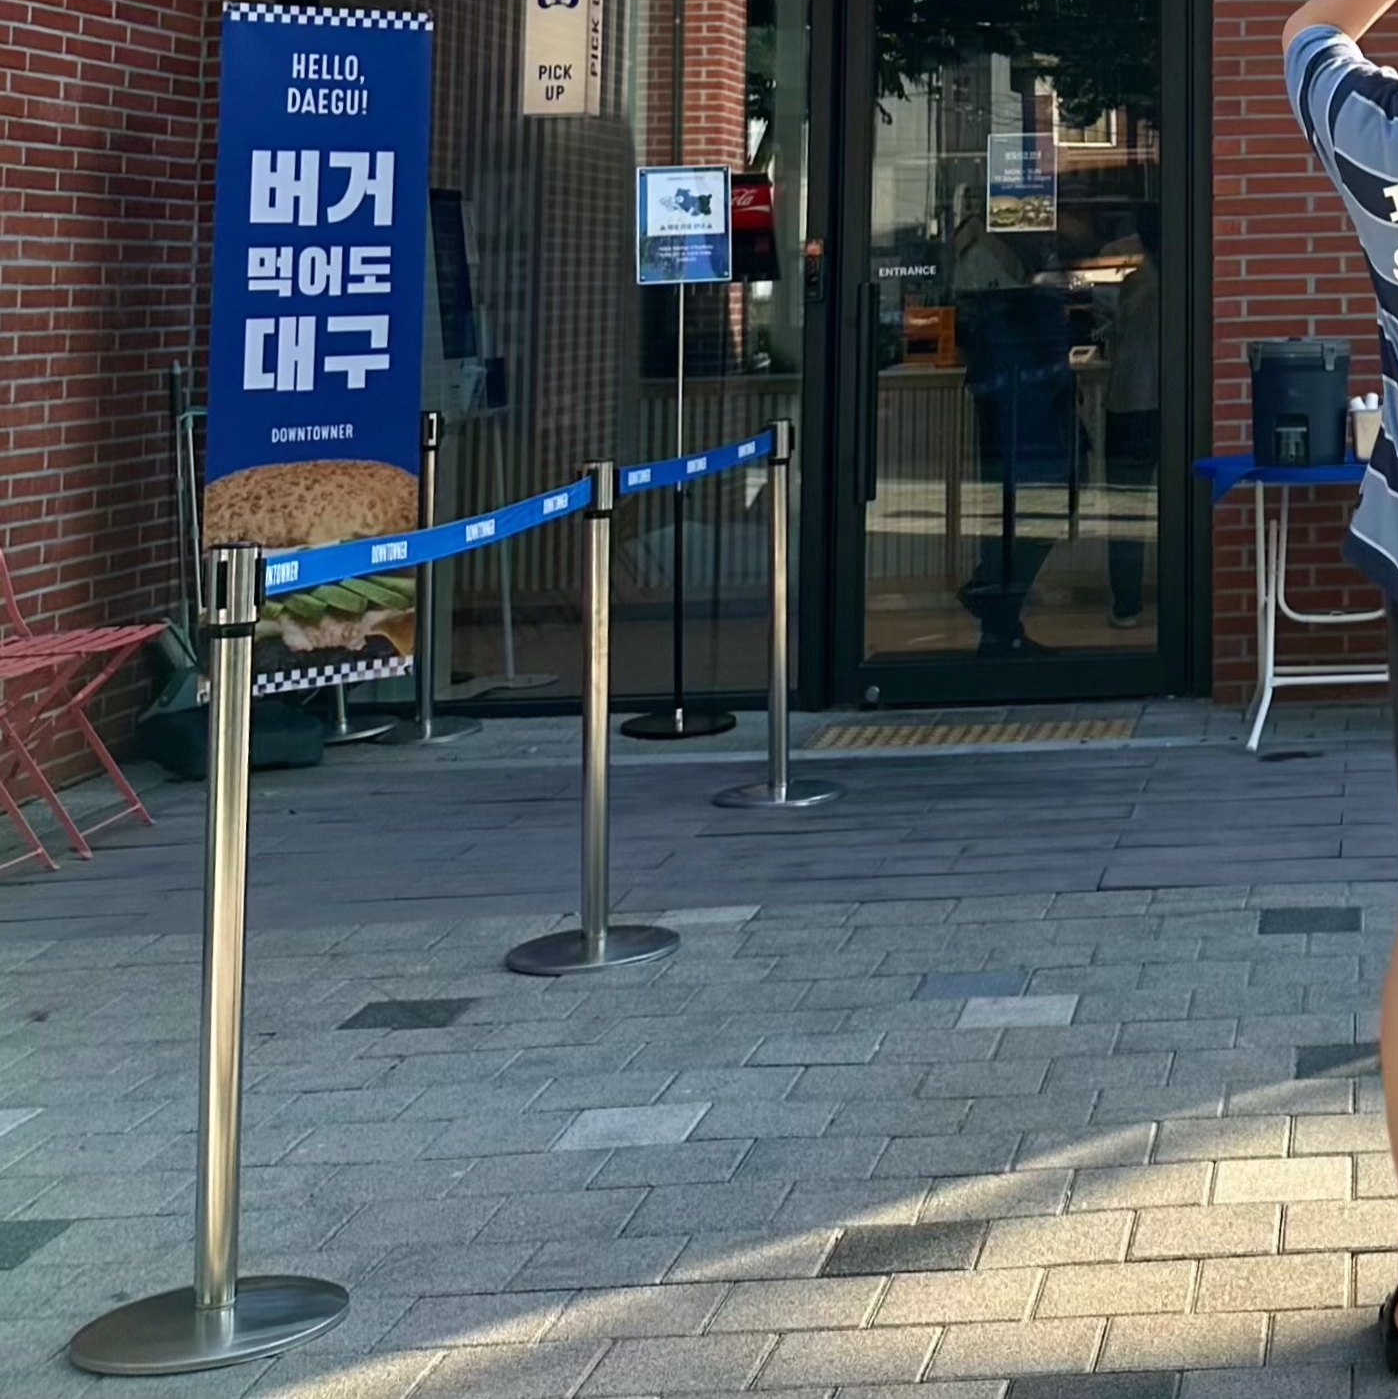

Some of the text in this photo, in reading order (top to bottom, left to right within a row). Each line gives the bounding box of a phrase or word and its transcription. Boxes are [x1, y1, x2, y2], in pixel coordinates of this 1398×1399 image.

[590, 21, 600, 78] PICK
[291, 52, 366, 85] HELLO,
[538, 64, 573, 81] PICK
[286, 87, 369, 116] DAEGU!
[545, 85, 565, 101] UP
[249, 149, 395, 227] 버거
[247, 245, 392, 298] 먹어도
[878, 265, 937, 278] ENTRANCE
[243, 313, 391, 392] 대구
[271, 423, 354, 444] DOWNTOWNER
